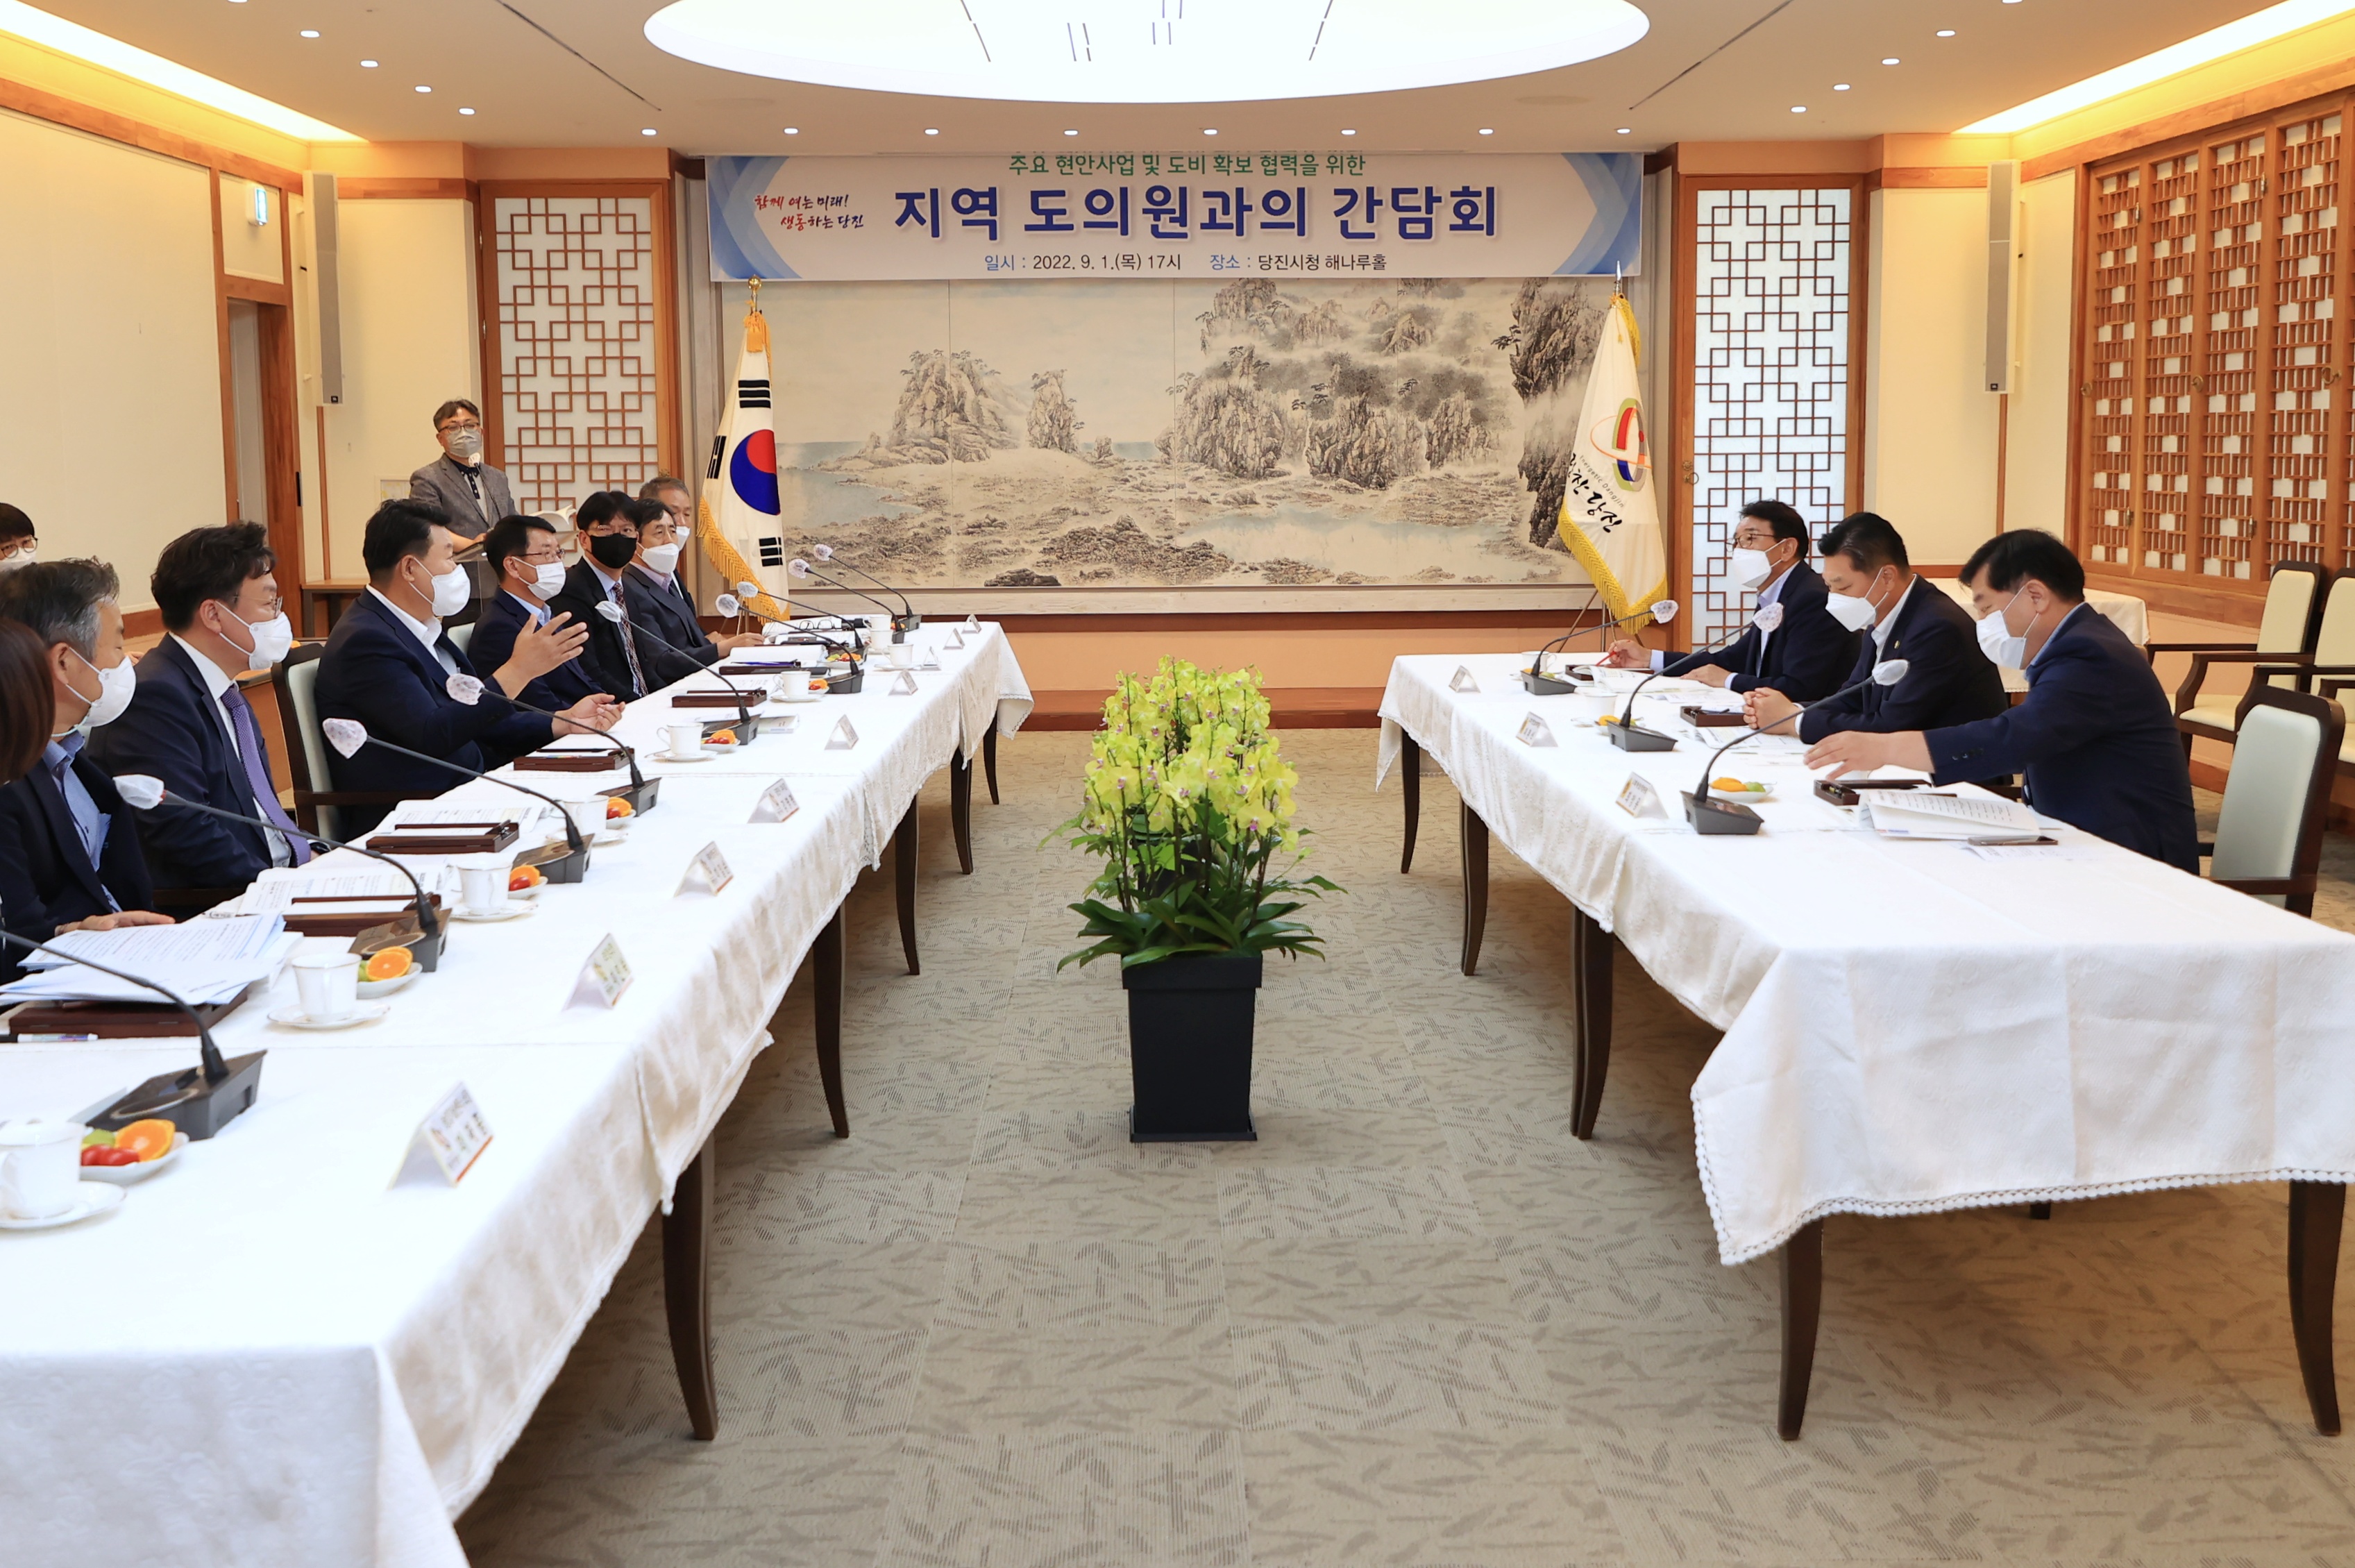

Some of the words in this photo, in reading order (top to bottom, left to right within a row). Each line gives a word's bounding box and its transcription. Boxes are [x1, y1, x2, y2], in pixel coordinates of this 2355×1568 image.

[1008, 155, 1049, 176] 주요
[1055, 153, 1134, 176] 현안사업
[1142, 154, 1160, 176] 및
[1167, 154, 1206, 175] 도비
[1213, 153, 1254, 177] 확보
[1260, 153, 1319, 176] 협력을
[1326, 154, 1366, 176] 위한
[754, 194, 785, 210] 함께
[788, 195, 813, 210] 여는
[817, 194, 850, 210] 미래!
[895, 186, 997, 241] 지역
[1024, 185, 1306, 239] 도의원과의
[1333, 185, 1495, 239] 간담회
[780, 213, 834, 232] 생동하는
[837, 214, 864, 229] 당진
[984, 254, 1015, 271] 일시
[1033, 254, 1076, 270] 2022.
[1081, 254, 1095, 270] 9.
[1101, 253, 1142, 271] 1.(목)
[1147, 253, 1181, 271] 17시
[1210, 254, 1240, 271] 장소
[1258, 254, 1319, 271] 당진시청
[1324, 253, 1387, 271] 해나루홀
[1602, 483, 1625, 508] Dangjin
[1587, 491, 1623, 533] 당진
